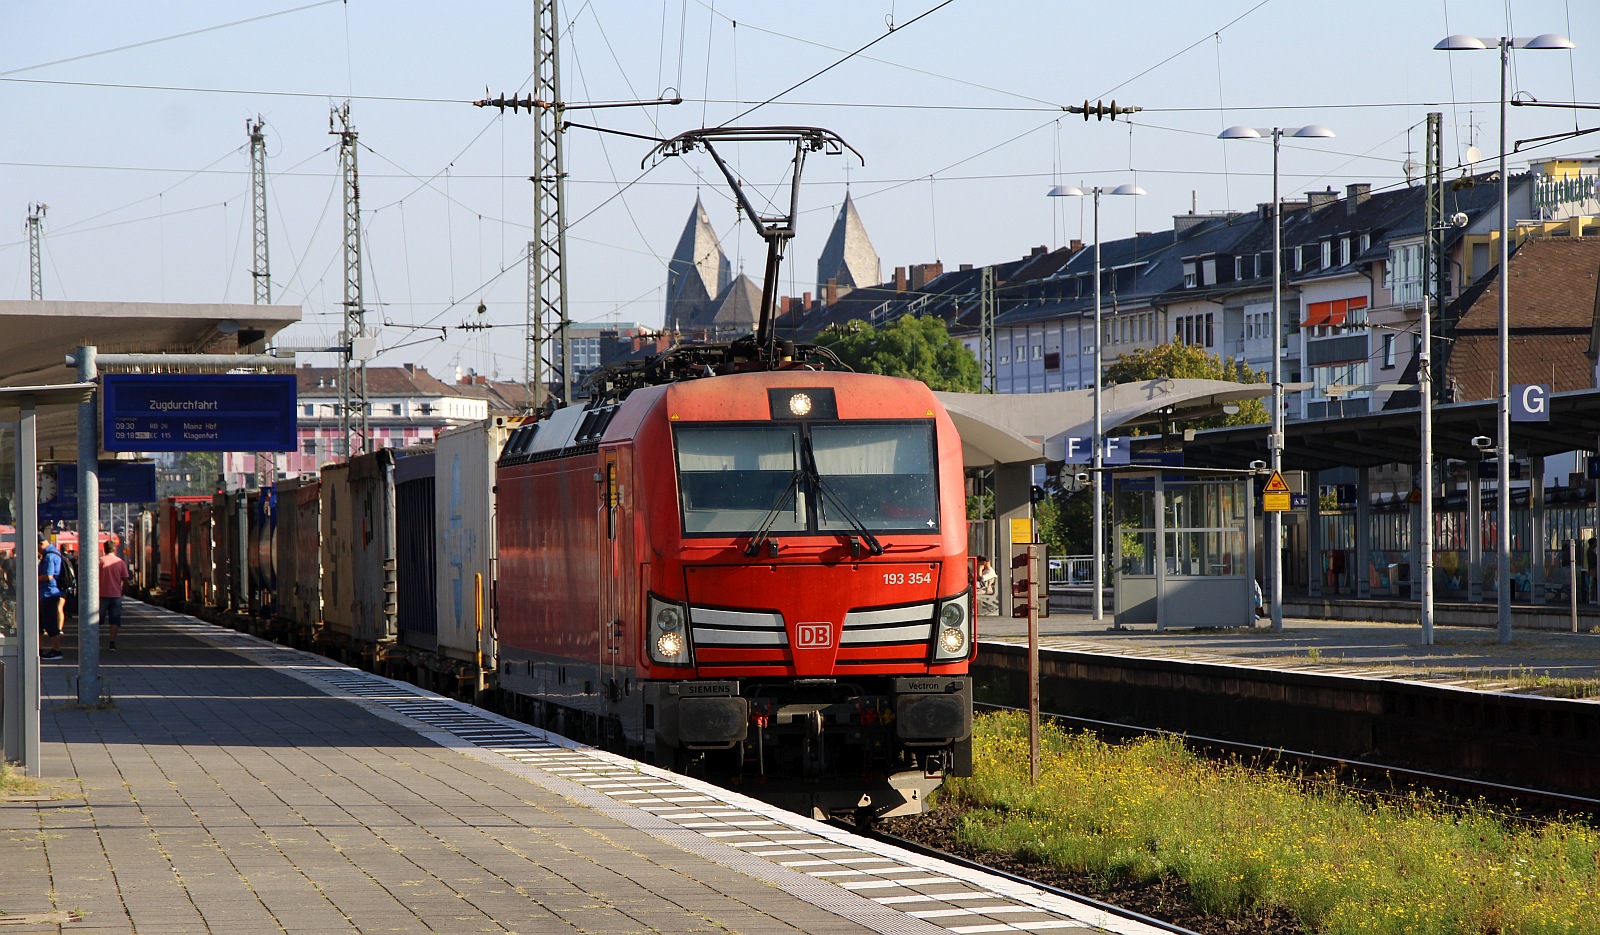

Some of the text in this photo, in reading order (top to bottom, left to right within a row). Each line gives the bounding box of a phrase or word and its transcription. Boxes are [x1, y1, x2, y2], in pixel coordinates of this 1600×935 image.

[1521, 384, 1545, 413] G
[149, 400, 218, 411] Zugdurchfahrt
[115, 422, 135, 430] 09:30
[183, 422, 217, 430] Mainz Hbf
[115, 431, 135, 439] 09:18
[183, 431, 218, 441] Klagenfurt
[1068, 437, 1081, 458] F
[1106, 437, 1120, 458] F
[56, 519, 65, 529] 4
[882, 571, 932, 585] 193 354
[800, 627, 829, 644] DB
[688, 684, 731, 695] SIEMENS
[908, 680, 940, 690] Vectron
